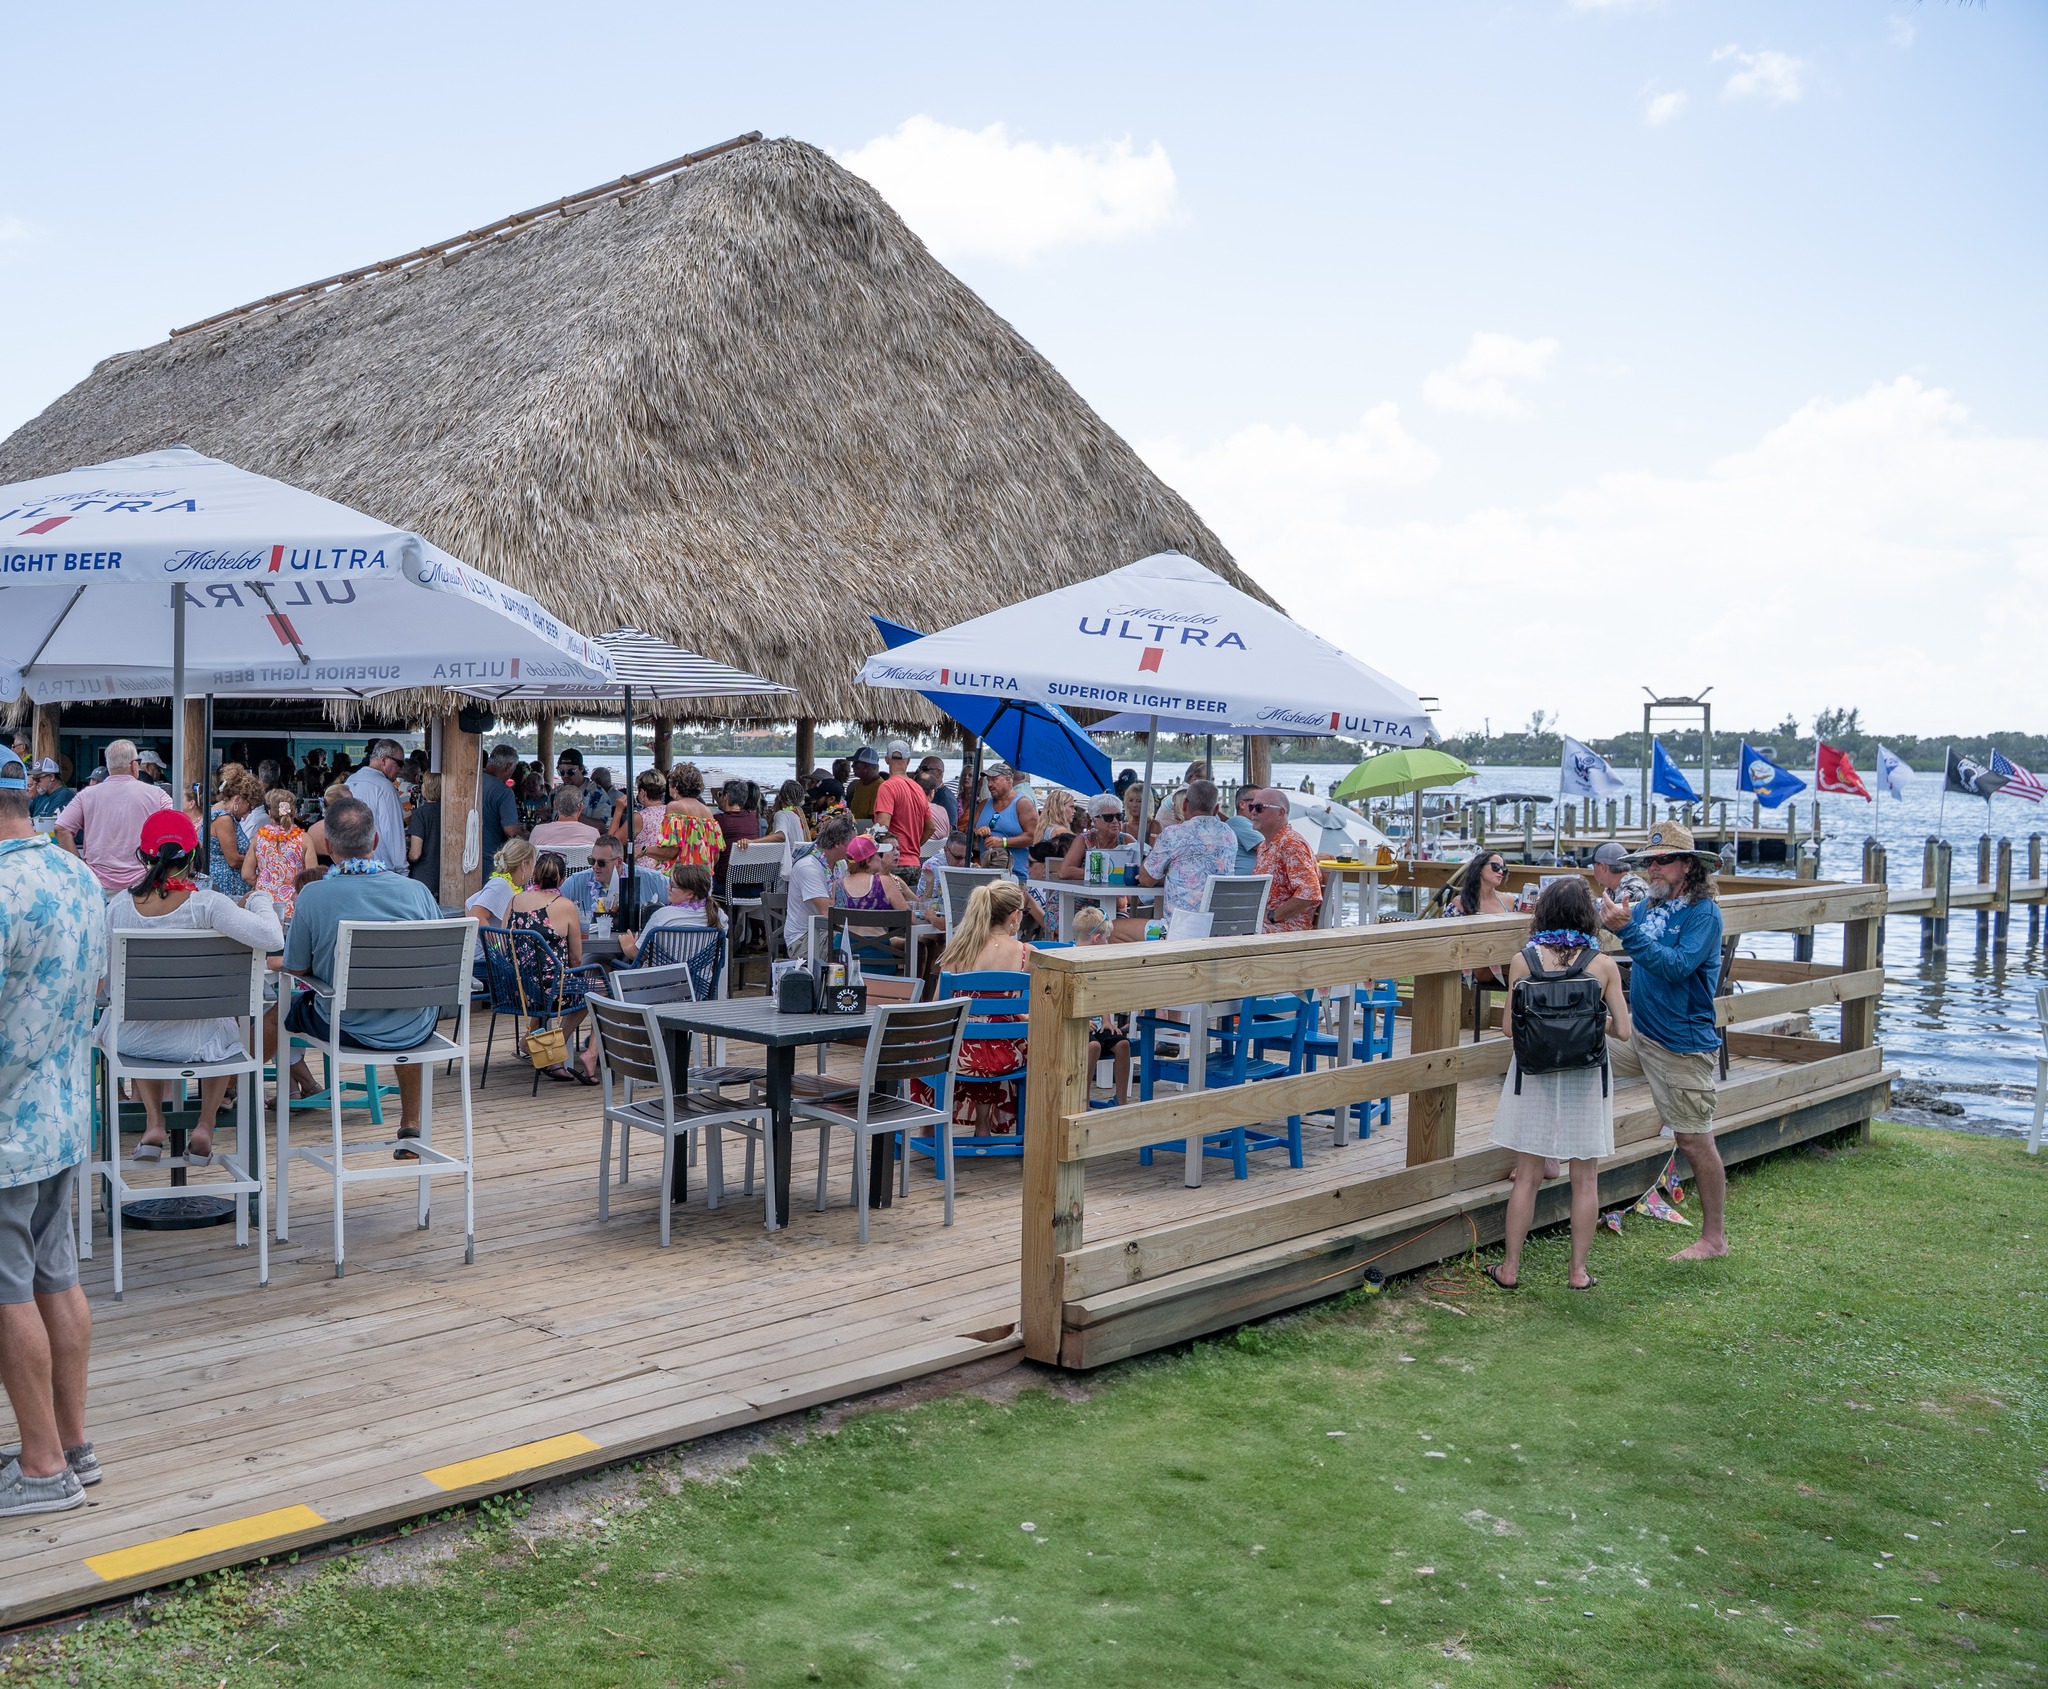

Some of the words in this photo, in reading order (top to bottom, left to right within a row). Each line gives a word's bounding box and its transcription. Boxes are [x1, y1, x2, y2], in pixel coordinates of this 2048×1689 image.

[0, 553, 58, 572] IGHT
[63, 551, 122, 570] BEER
[164, 549, 267, 572] Michelob
[290, 549, 386, 570] ULTRA
[1106, 604, 1222, 625] Michelob
[1078, 616, 1247, 650] ULTRA
[871, 665, 938, 682] Michelob
[954, 672, 1018, 691] ULTRA
[1047, 682, 1129, 703] SUPERIOR
[1132, 693, 1182, 711] LIGHT
[1185, 699, 1229, 715] BEER
[1256, 706, 1327, 726] Michelob
[1345, 716, 1412, 738] ULTRA
[836, 988, 859, 1001] STELLA
[836, 1000, 860, 1012] ARTOIS
